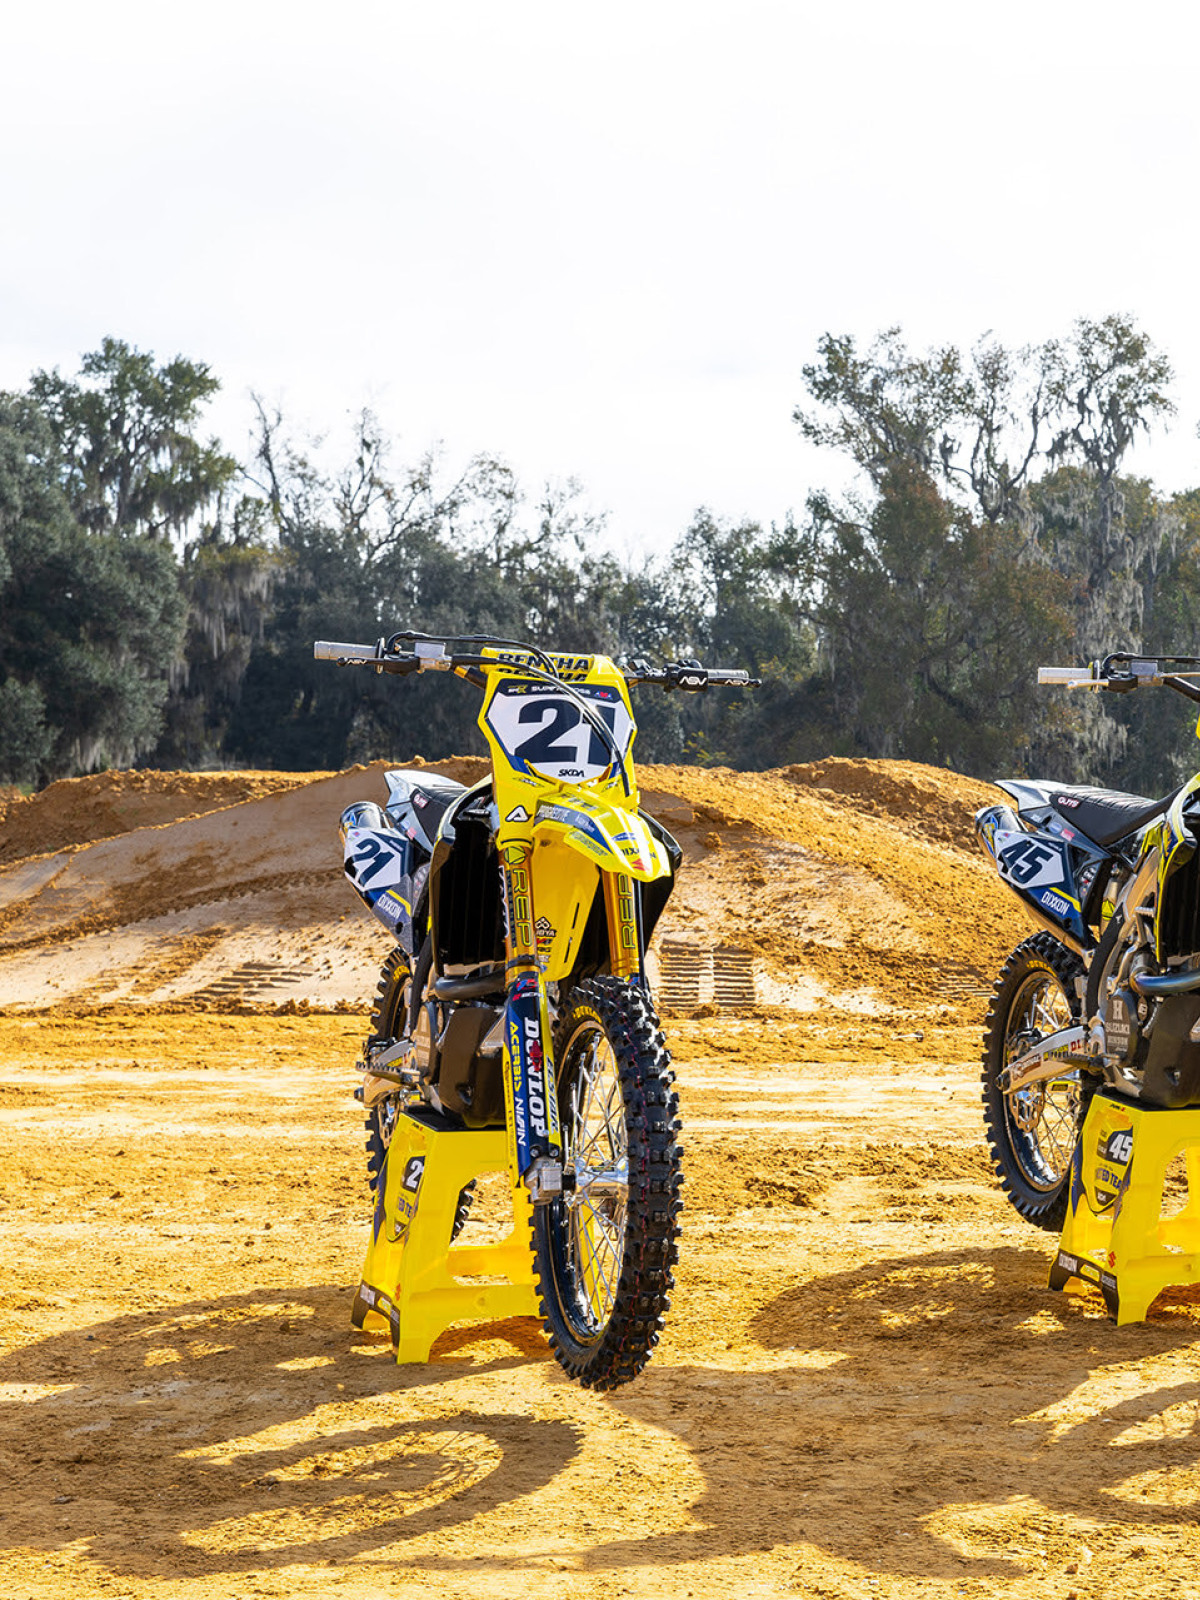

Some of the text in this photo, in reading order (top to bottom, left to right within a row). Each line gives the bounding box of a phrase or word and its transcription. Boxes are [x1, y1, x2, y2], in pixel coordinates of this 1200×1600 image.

[679, 676, 708, 686] ASV
[514, 698, 616, 767] 21
[558, 768, 585, 778] SKDA
[351, 838, 395, 888] 21
[1001, 839, 1054, 885] 45
[513, 868, 533, 948] REP
[1041, 891, 1070, 916] DIXXON
[1105, 1021, 1130, 1034] SUZUKI
[509, 1021, 523, 1092] ACERBIS
